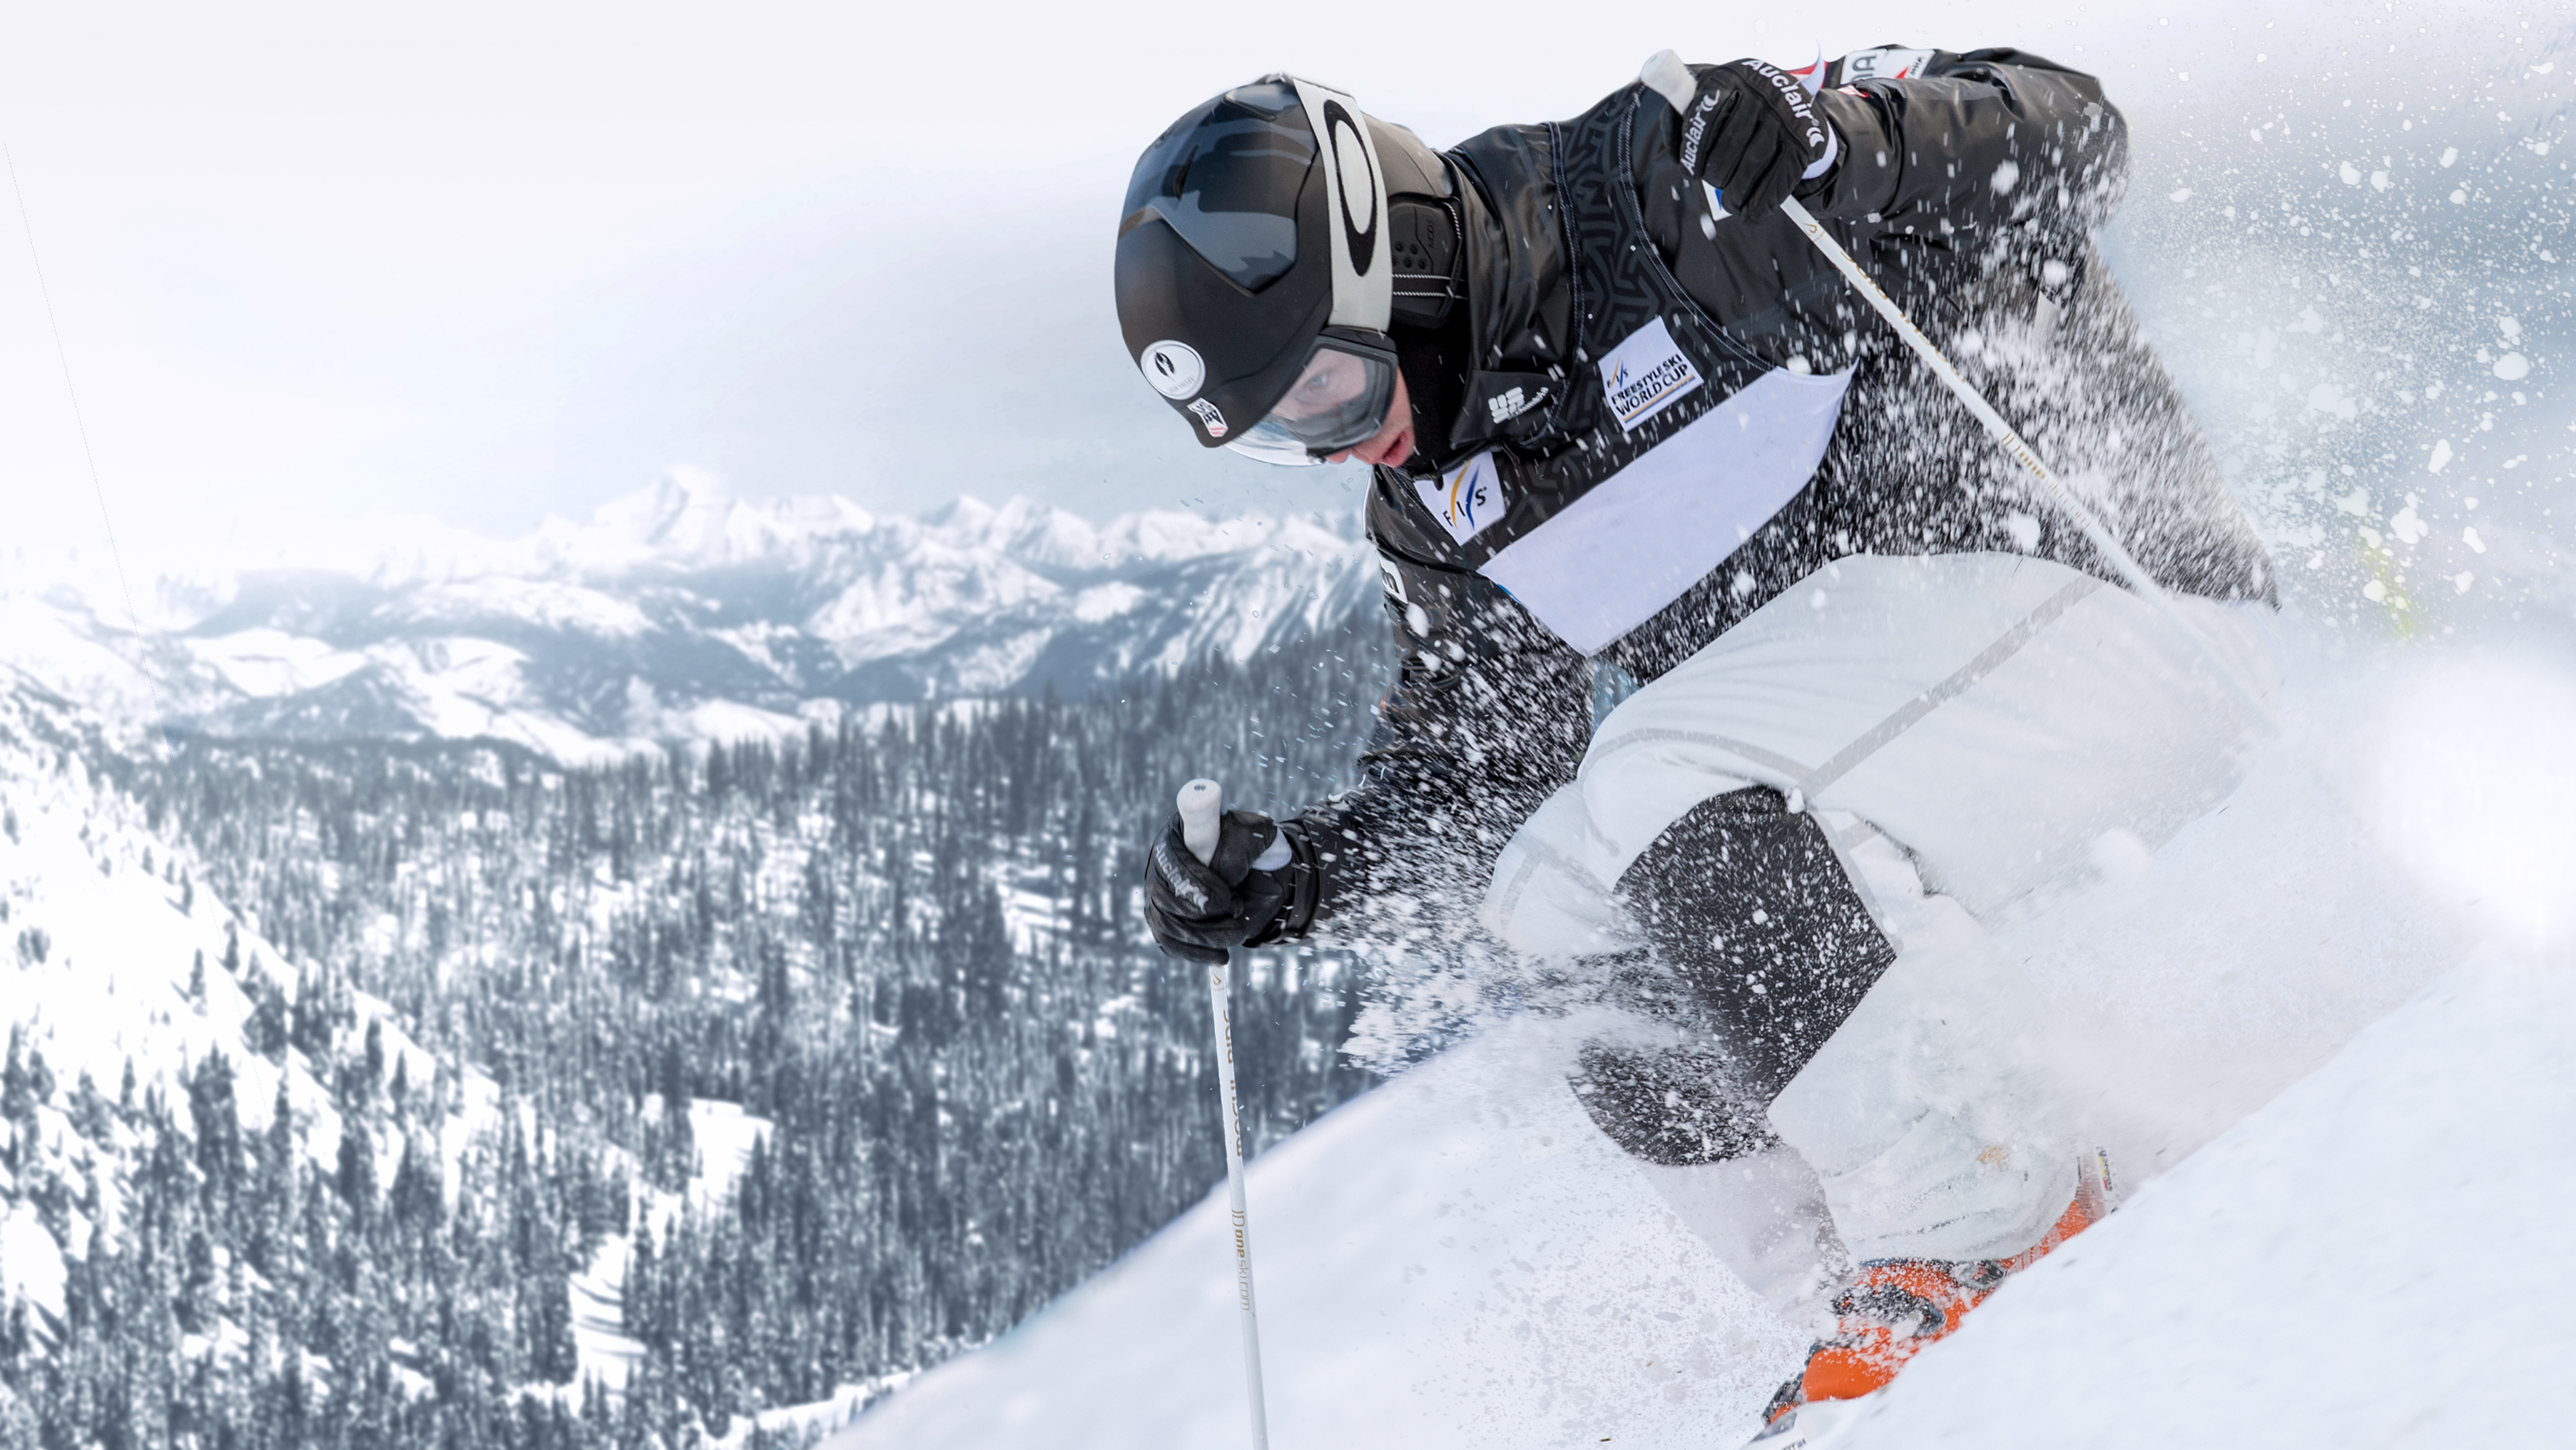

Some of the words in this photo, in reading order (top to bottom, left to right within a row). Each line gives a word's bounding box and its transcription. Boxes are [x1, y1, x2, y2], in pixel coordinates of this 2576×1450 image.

[1741, 59, 1815, 120] Auclair
[1679, 111, 1705, 176] Auclair
[1612, 365, 1664, 405] FREESTYLE
[1663, 354, 1682, 371] SKI
[1616, 381, 1662, 416] WORLD
[1663, 364, 1688, 387] CUP
[1443, 487, 1486, 527] FIS
[1156, 842, 1193, 896] Auclair
